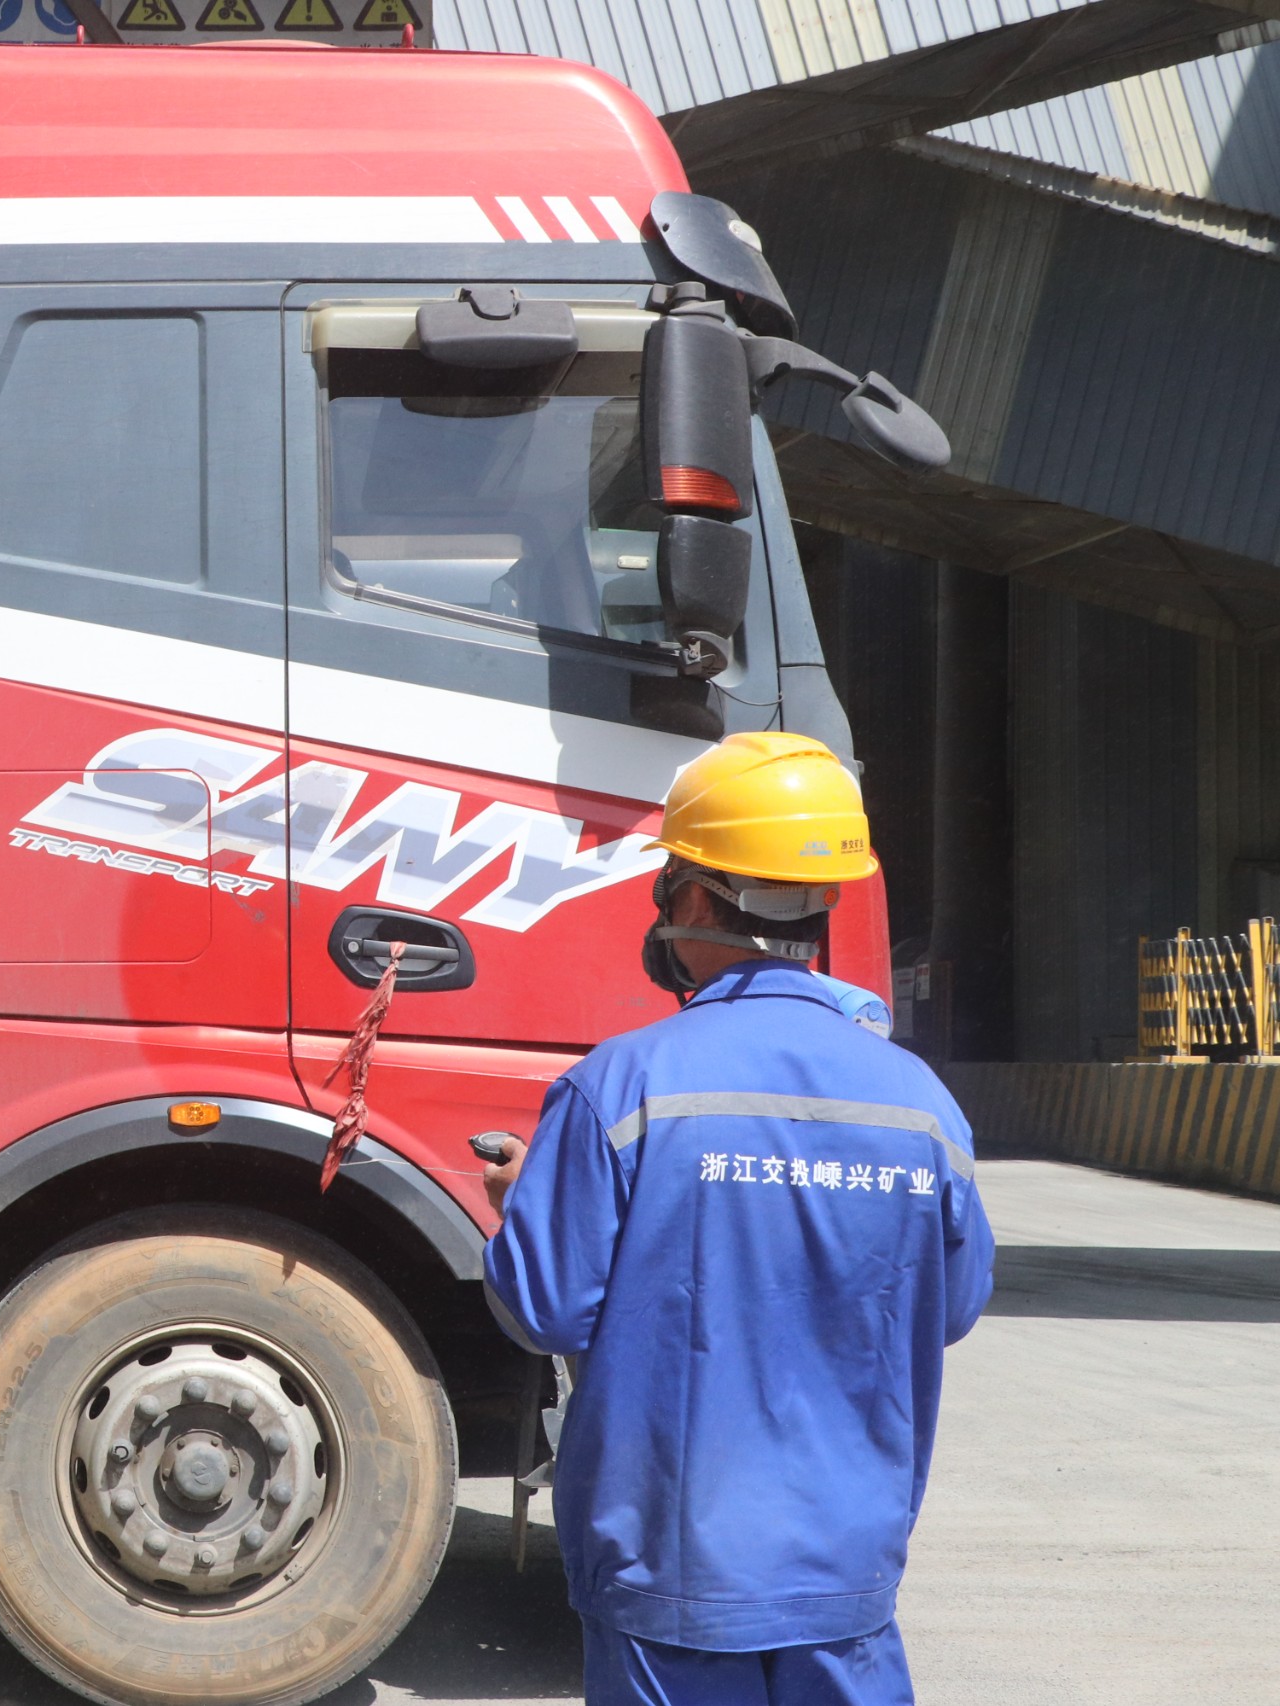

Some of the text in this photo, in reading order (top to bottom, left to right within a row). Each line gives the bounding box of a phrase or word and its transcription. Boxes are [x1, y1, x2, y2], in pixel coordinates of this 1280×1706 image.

[8, 827, 275, 897] TRANSPORT
[20, 727, 667, 932] SANY
[699, 1152, 936, 1196] 浙江交投嵊兴矿业
